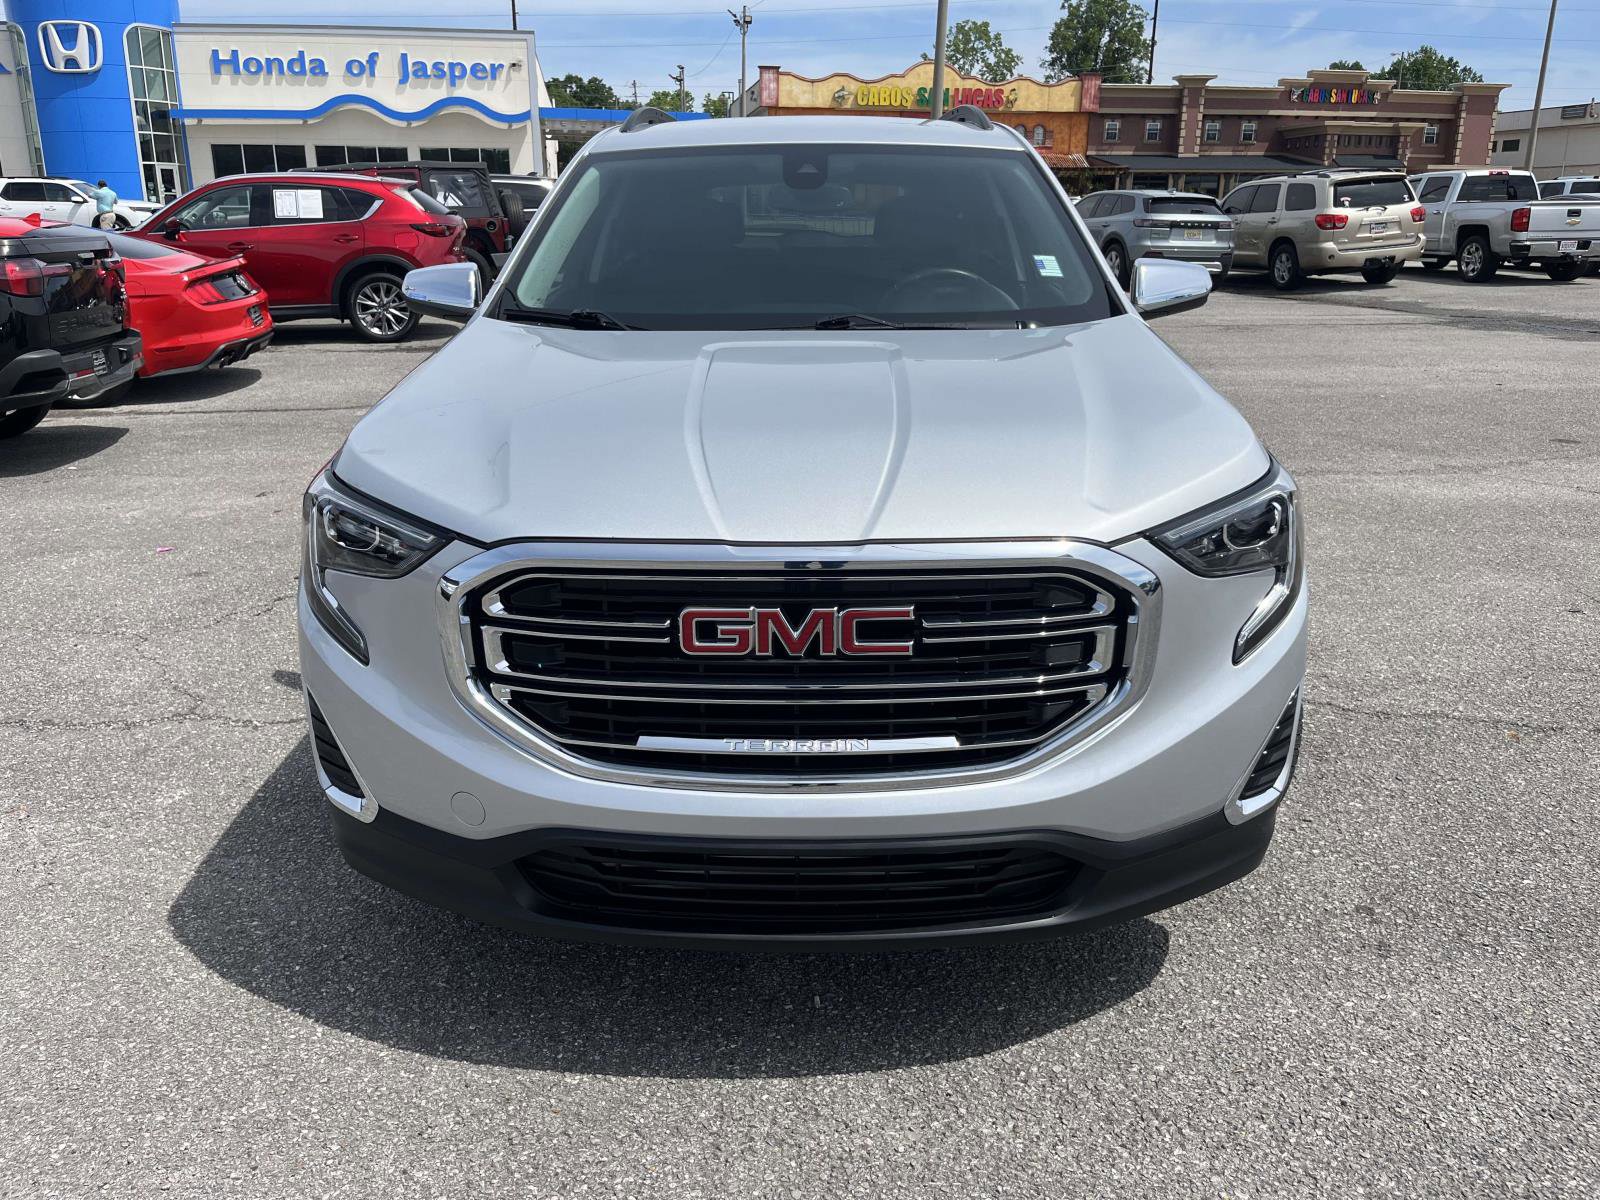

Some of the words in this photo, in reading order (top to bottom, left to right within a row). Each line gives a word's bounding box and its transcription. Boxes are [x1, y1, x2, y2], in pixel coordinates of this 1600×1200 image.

[211, 49, 329, 76] Honda
[345, 51, 379, 78] of
[398, 52, 505, 88] Jasper
[857, 85, 914, 107] CABOS
[955, 88, 1005, 108] LUCAS
[1330, 88, 1347, 104] SAN
[679, 606, 914, 656] GMC
[723, 738, 869, 751] TERRAIN
